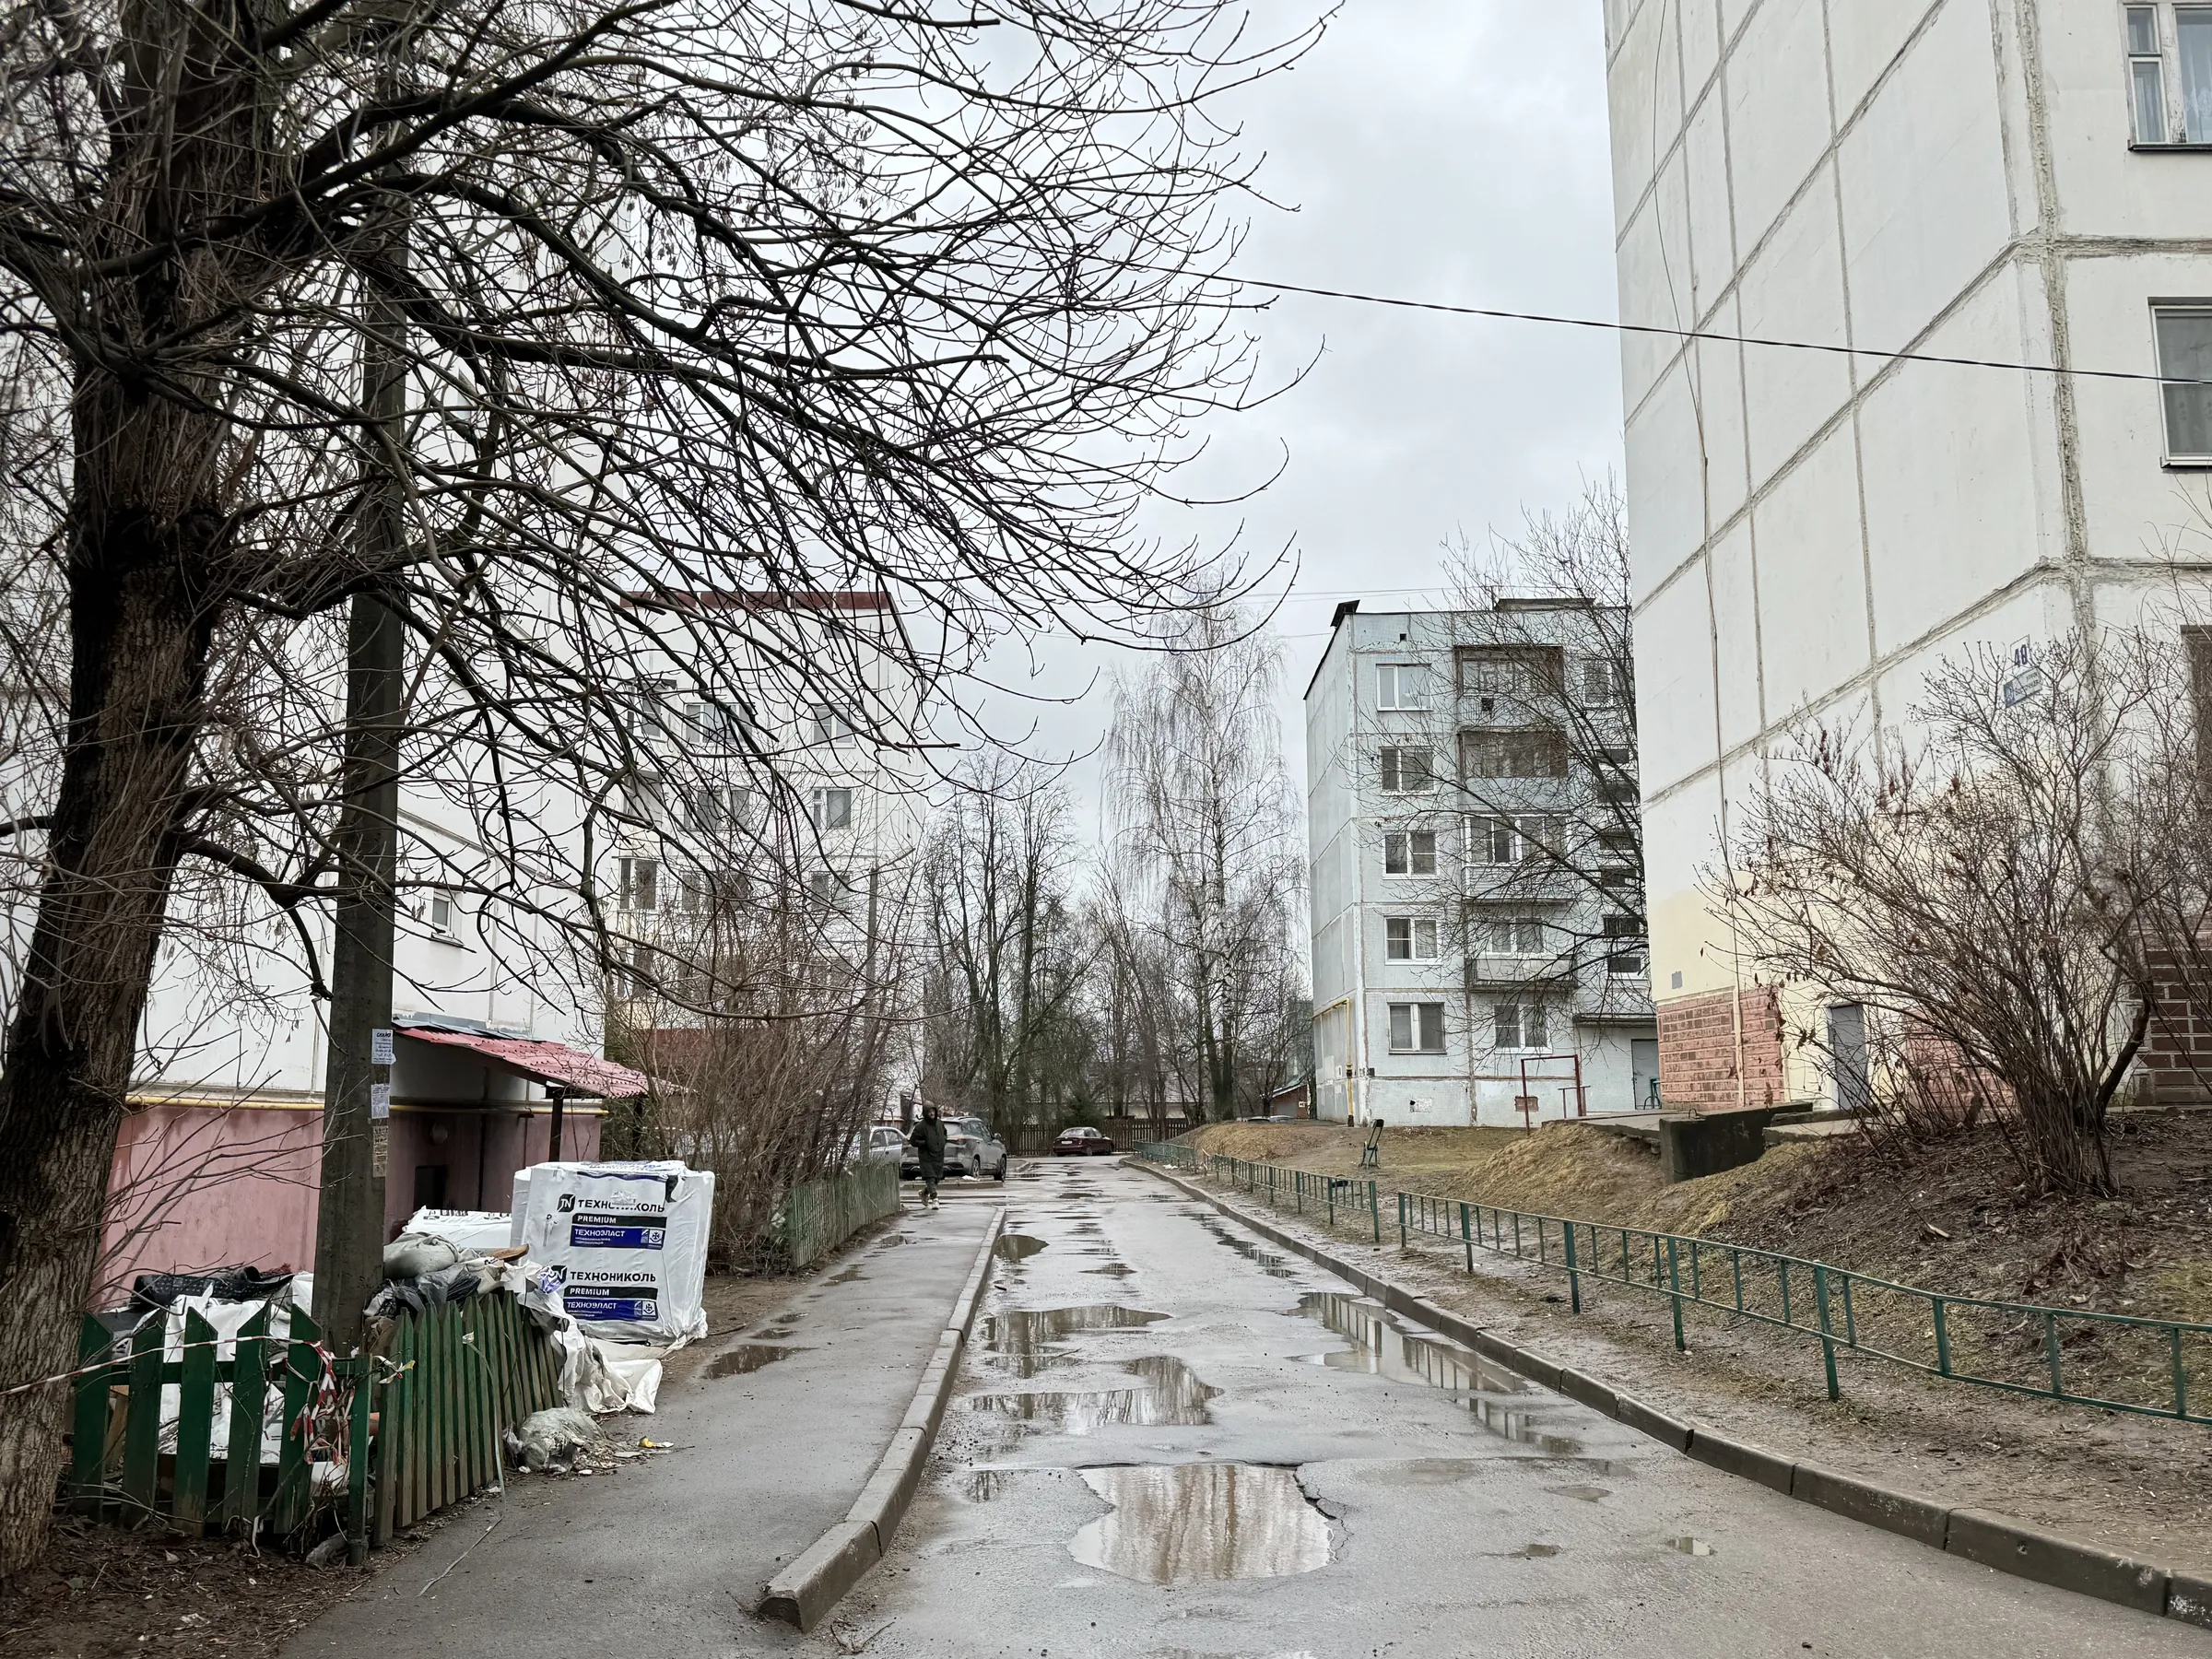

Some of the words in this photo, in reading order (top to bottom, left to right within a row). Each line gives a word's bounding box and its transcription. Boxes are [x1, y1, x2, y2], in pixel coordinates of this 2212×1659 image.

[578, 1199, 665, 1213] ТЕХНОКОЛЬ
[577, 1215, 618, 1224] PREMIUM
[574, 1228, 626, 1237] ТЕХНОЭЛАСТ
[570, 1271, 656, 1282] ТЕХНОНИКОЛЬ
[570, 1288, 610, 1296] PREMIUM
[567, 1301, 618, 1310] ТЕХНОЭЛАСТ
